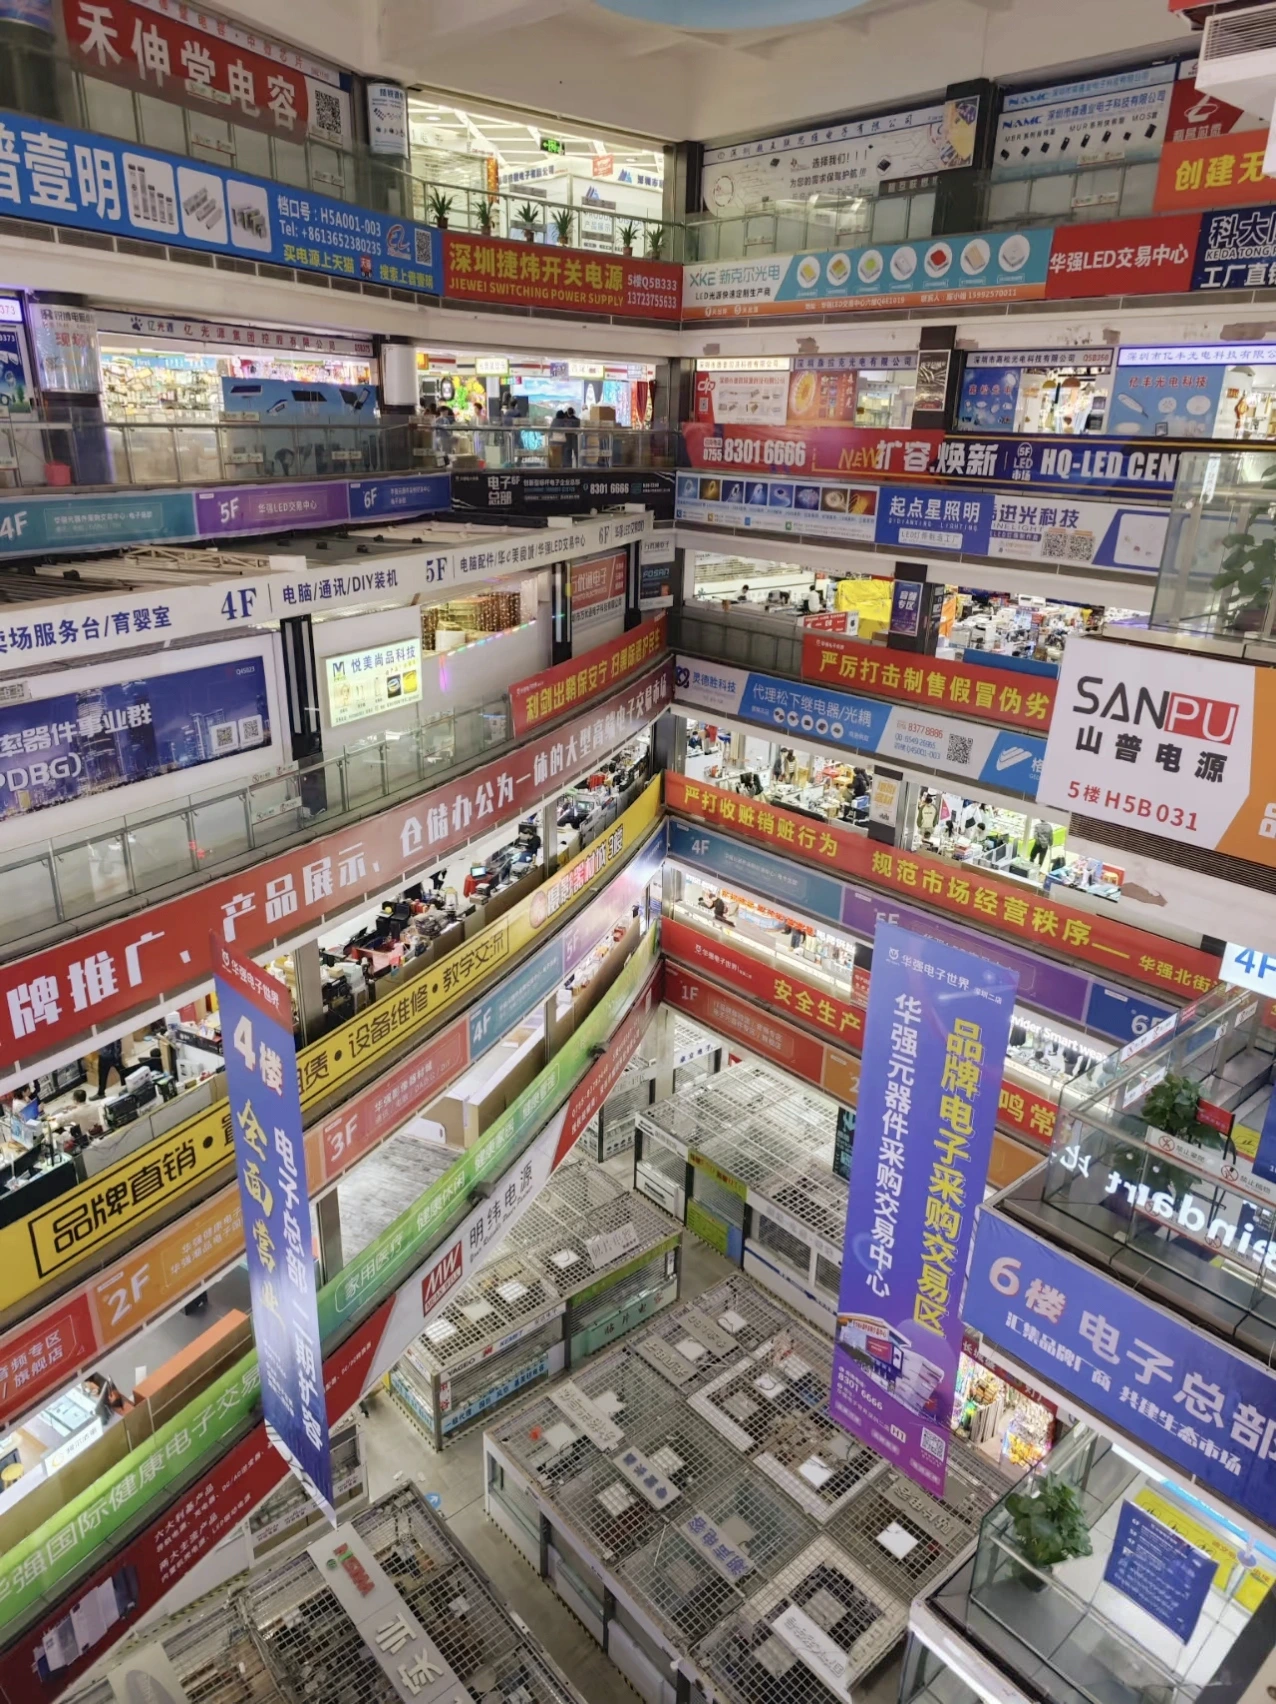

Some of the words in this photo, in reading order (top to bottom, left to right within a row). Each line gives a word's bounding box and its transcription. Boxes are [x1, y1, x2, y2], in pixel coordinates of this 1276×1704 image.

[77, 2, 298, 131] 禾伸堂电容
[279, 219, 299, 238] Tel:
[301, 227, 382, 256] +8613652380235
[320, 207, 382, 237] H5A001-003
[1208, 211, 1276, 249] 科大
[283, 244, 355, 274] 买电源上天猫
[449, 242, 625, 292] 深圳捷炜开关电源
[689, 270, 716, 288] XKE
[719, 264, 780, 285] 新克尔光电
[1048, 242, 1189, 275] 华强LED交易中心
[449, 277, 487, 293] JIEWEI
[489, 281, 550, 300] SWITCHING
[550, 287, 587, 304] POWER
[588, 291, 624, 308] SUPPLY
[626, 291, 677, 310] 13723755633
[1128, 375, 1208, 388] 亿丰光电科技
[703, 448, 723, 462] 0755
[724, 438, 760, 464] 8301
[763, 439, 807, 467] 6666
[1013, 457, 1034, 470] LED
[1039, 448, 1123, 480] HQ-LED
[487, 475, 512, 490] 电子
[590, 483, 609, 495] 8301
[610, 483, 630, 495] 6666
[1012, 469, 1032, 482] 市场
[219, 496, 240, 524] 5F
[257, 499, 318, 514] 华强LED交易中心
[363, 487, 378, 509] 6F
[487, 490, 512, 506] 总部
[888, 496, 981, 523] 起点星照明
[0, 510, 28, 542] 4F
[599, 521, 610, 544] 6F
[425, 556, 448, 583] 5F
[220, 586, 258, 621] 4F
[282, 569, 399, 606] 电脑/通讯/DIY装机
[350, 645, 416, 674] 悦美尚品科技
[818, 649, 1050, 720] 严厉打击制售假冒伪劣
[752, 682, 873, 729] 代理松下继电器/光耦
[1072, 675, 1240, 744] SANPU
[1075, 724, 1228, 784] 山普电源
[684, 783, 839, 858] 严打收赃销赃行为
[1066, 780, 1198, 832] 5楼H5B031
[691, 838, 711, 856] 4F
[230, 958, 280, 1012] 华强电子世界
[901, 954, 970, 992] 华强电子世界
[681, 985, 699, 1001] 1F
[774, 978, 862, 1032] 安全生产
[472, 1006, 493, 1044] 4F
[1044, 1023, 1079, 1052] Smart
[233, 1014, 284, 1097] 4楼
[53, 1138, 198, 1254] 品牌直销
[348, 983, 429, 1060] 设备维修
[443, 931, 508, 993] 教学交流
[330, 1113, 359, 1163] 3F
[865, 993, 923, 1299] 华强元器件采购交易中心
[912, 1017, 984, 1338] 品牌电子采购交易区
[469, 1159, 533, 1249] 明纬电源
[343, 1233, 404, 1301] 家用医疗
[416, 1169, 466, 1232] 健康休闲
[106, 1263, 151, 1327] 2F
[14, 1351, 64, 1389] 旗舰店
[987, 1255, 1068, 1323] 6楼
[1078, 1309, 1276, 1460] 电子总部
[837, 1372, 860, 1393] 8301
[860, 1388, 884, 1411] 6666
[1003, 1310, 1112, 1393] 汇集品牌厂商
[1119, 1387, 1243, 1476] 共建生态市场
[154, 1482, 214, 1541] 六大利基产品
[158, 1511, 219, 1573] 两大主流产品
